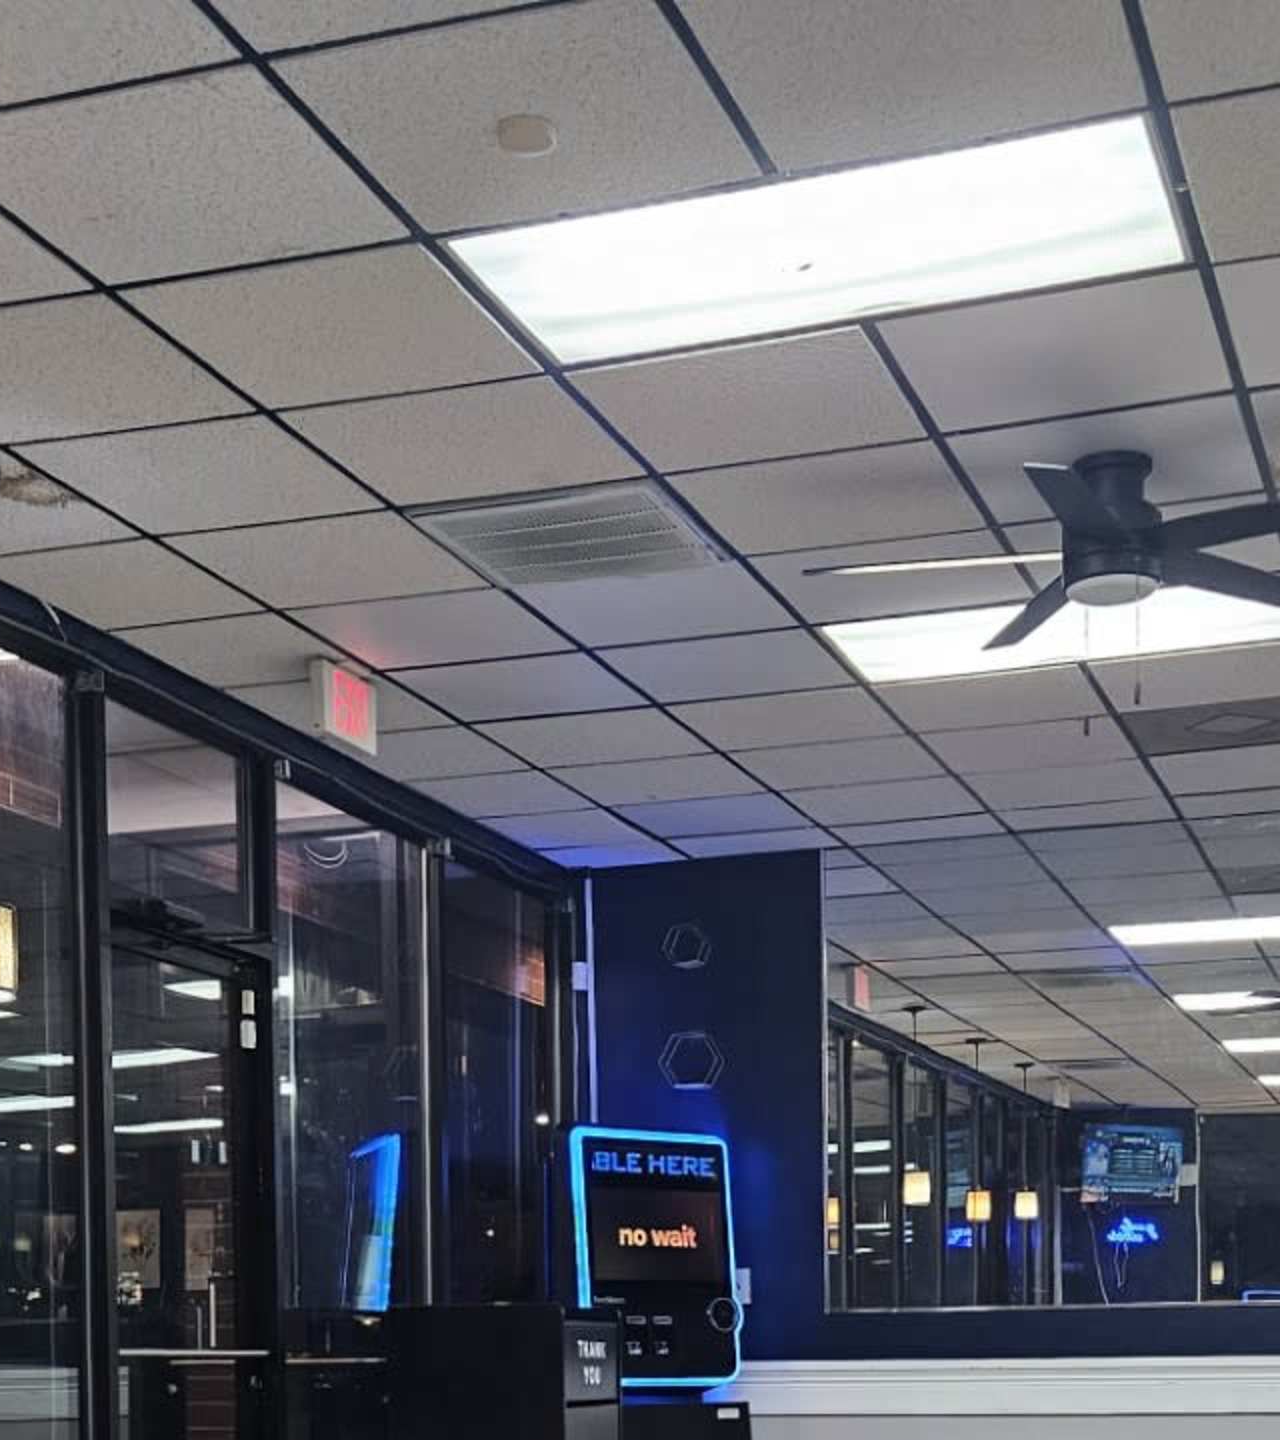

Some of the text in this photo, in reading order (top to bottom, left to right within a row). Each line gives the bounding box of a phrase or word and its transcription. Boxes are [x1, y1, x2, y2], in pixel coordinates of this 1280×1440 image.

[592, 1151, 716, 1178] BLE HERE
[618, 1224, 697, 1249] no wait
[577, 1340, 607, 1359] THANK
[583, 1366, 600, 1385] YOU
